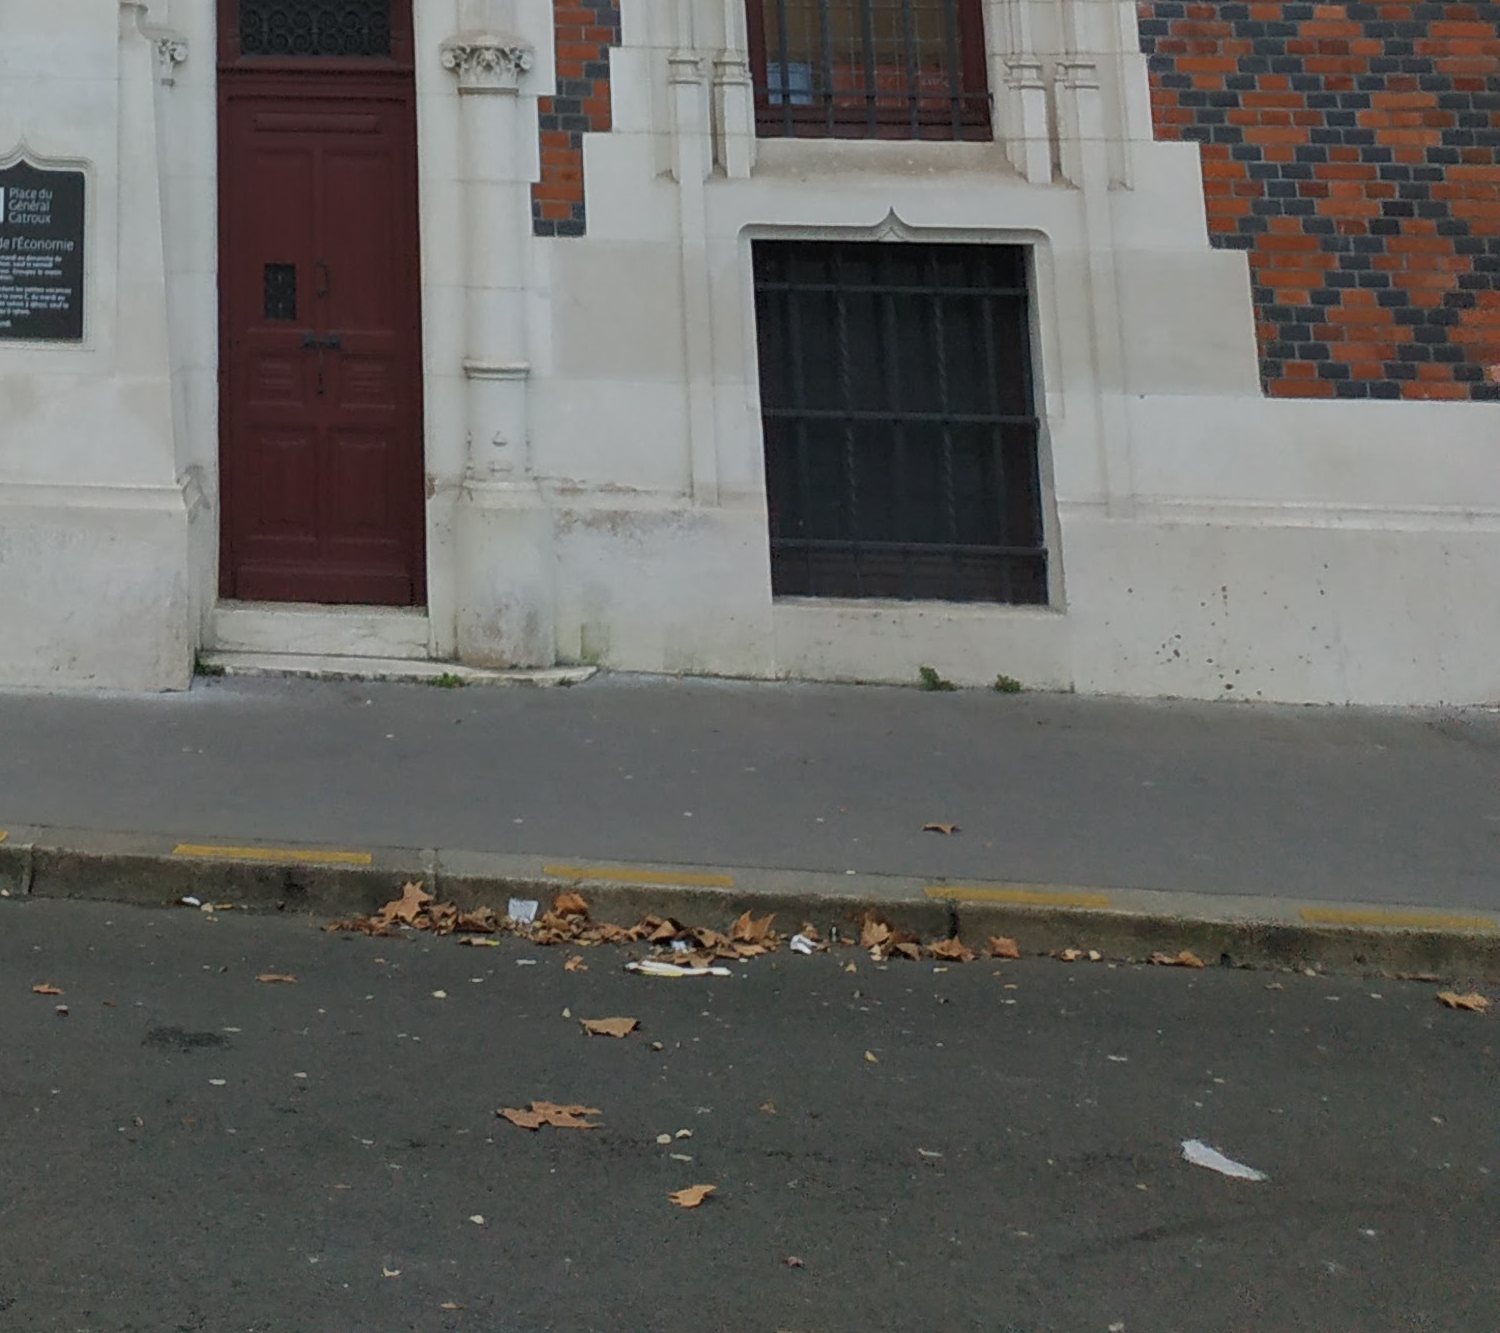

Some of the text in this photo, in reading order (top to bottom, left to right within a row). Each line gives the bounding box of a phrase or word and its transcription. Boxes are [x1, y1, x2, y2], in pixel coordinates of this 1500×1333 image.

[9, 187, 53, 199] Place du
[8, 199, 50, 211] Général
[8, 212, 51, 223] Catroux
